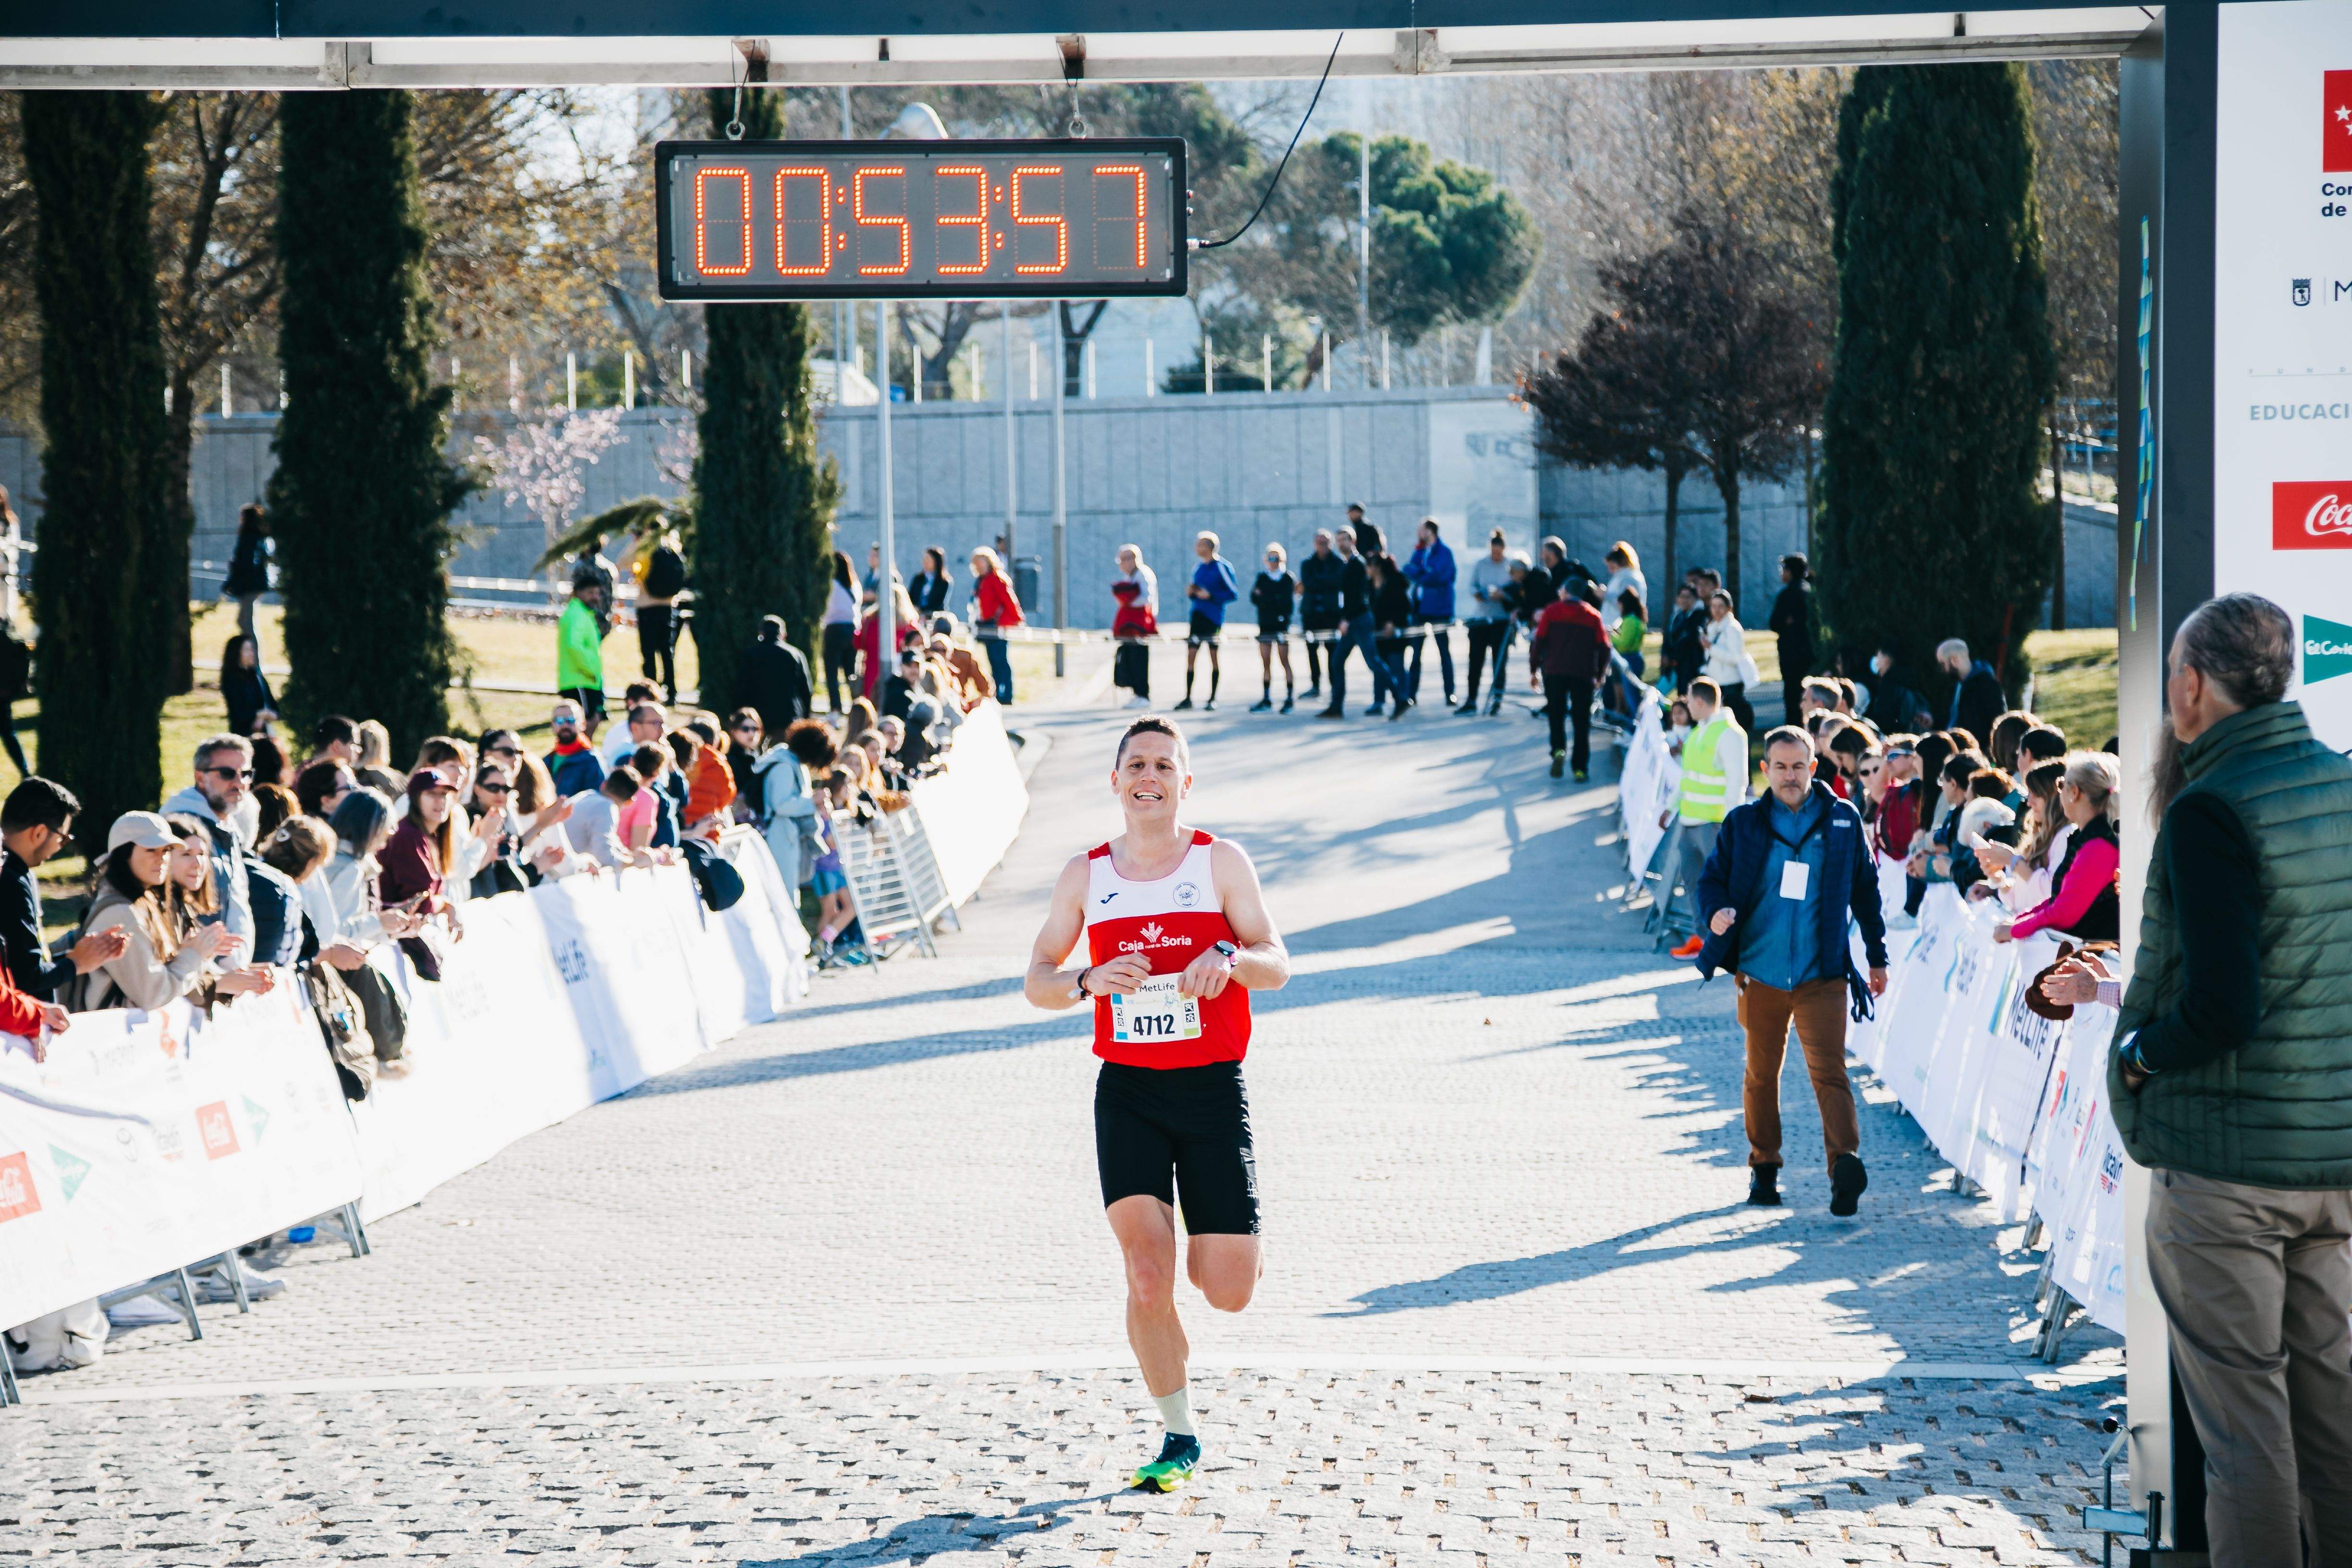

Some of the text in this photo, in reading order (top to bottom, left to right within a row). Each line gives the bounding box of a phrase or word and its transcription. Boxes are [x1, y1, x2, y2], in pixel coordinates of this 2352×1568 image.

[2321, 202, 2346, 217] de
[695, 166, 1147, 275] 00:53:57
[2250, 403, 2352, 420] EDUCACI
[1118, 940, 1144, 954] Caja
[1161, 935, 1192, 947] Soria
[1139, 982, 1175, 992] MetLife
[1134, 1014, 1176, 1036] 4712
[2004, 979, 2049, 1061] MetLife
